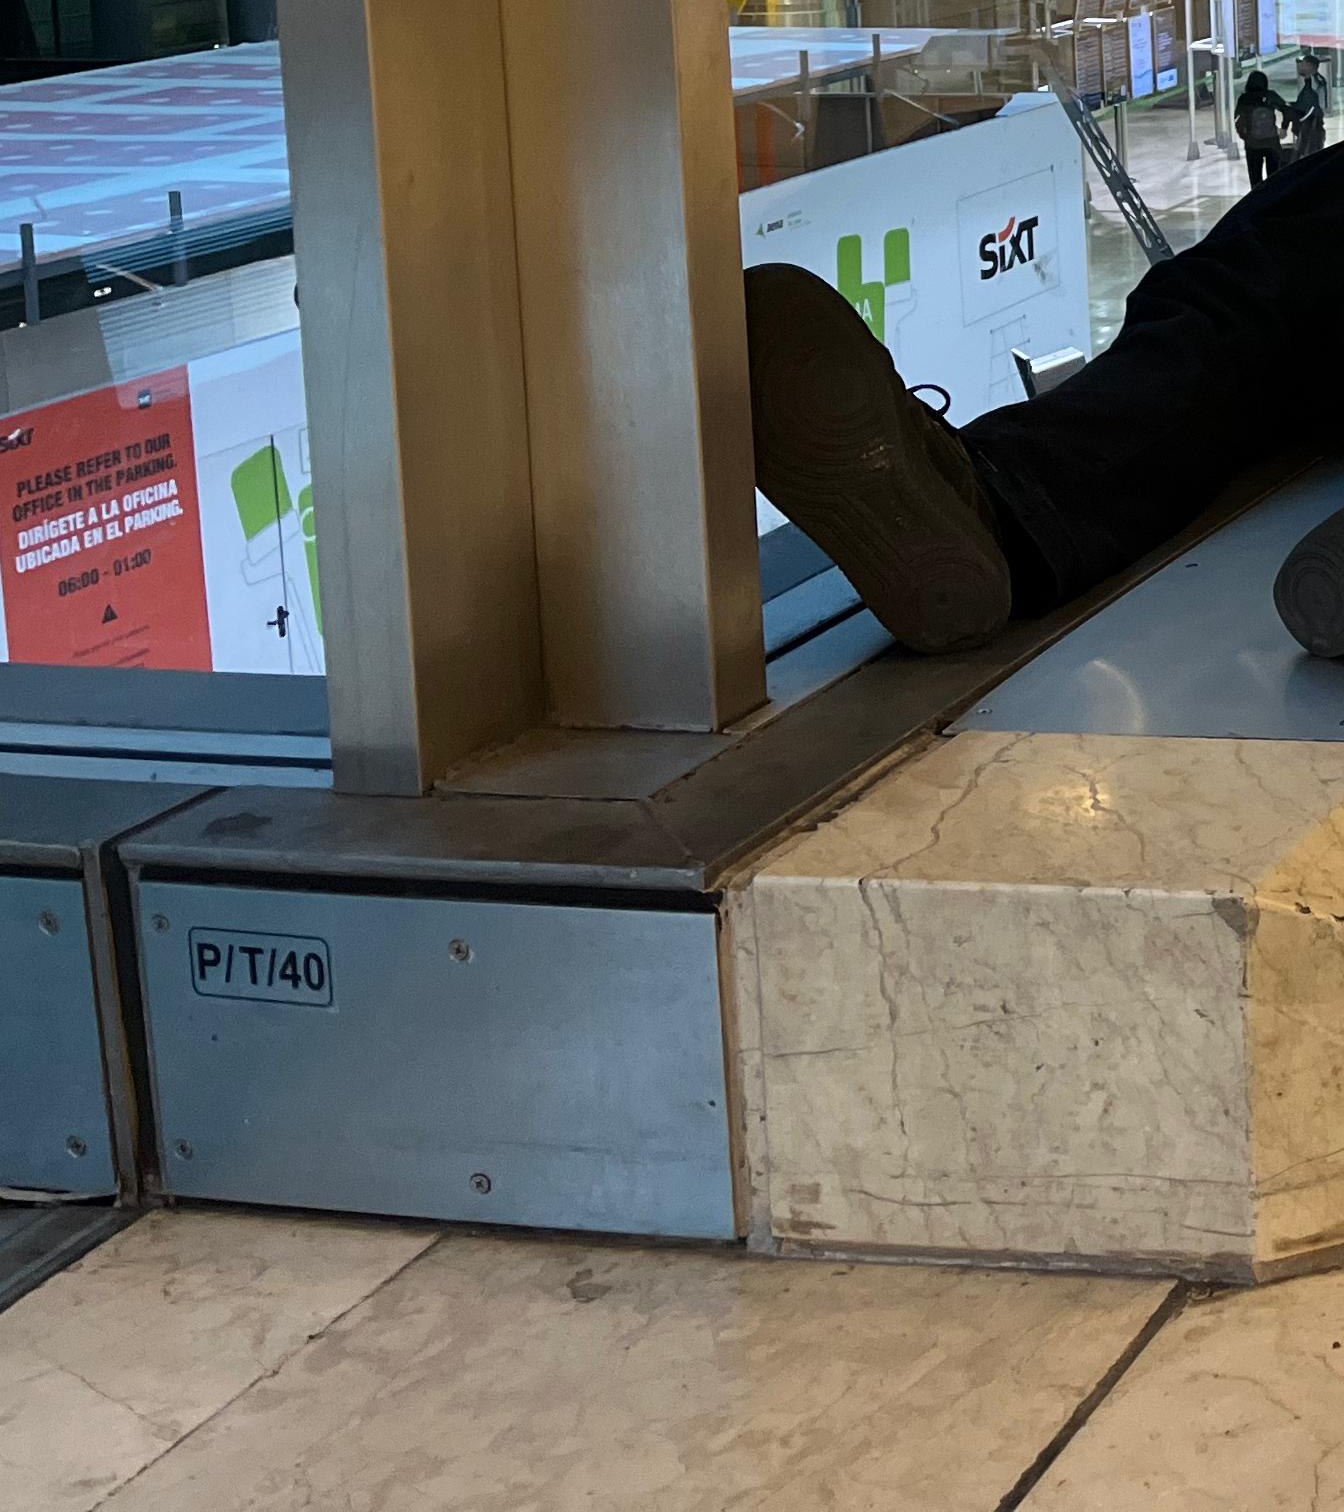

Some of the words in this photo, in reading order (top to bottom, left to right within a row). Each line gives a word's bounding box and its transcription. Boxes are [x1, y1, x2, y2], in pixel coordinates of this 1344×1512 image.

[12, 491, 64, 522] OFFICE
[68, 485, 83, 503] IN
[86, 476, 112, 496] THE
[116, 453, 177, 486] PARKING.
[17, 466, 72, 497] PLEASE
[76, 450, 121, 478] REFER
[126, 443, 142, 460] TO
[145, 433, 171, 454] OUR
[15, 535, 82, 573] UBICADA
[83, 526, 104, 549] EN
[106, 520, 123, 540] EL
[124, 499, 184, 533] PARKING.
[18, 511, 85, 550] DIRÍGETE
[88, 507, 99, 525] A
[101, 499, 120, 520] LA
[123, 479, 178, 512] OFICINA
[58, 568, 100, 597] 06:00
[113, 549, 152, 576] 01:00
[197, 942, 325, 991] P/T/40
